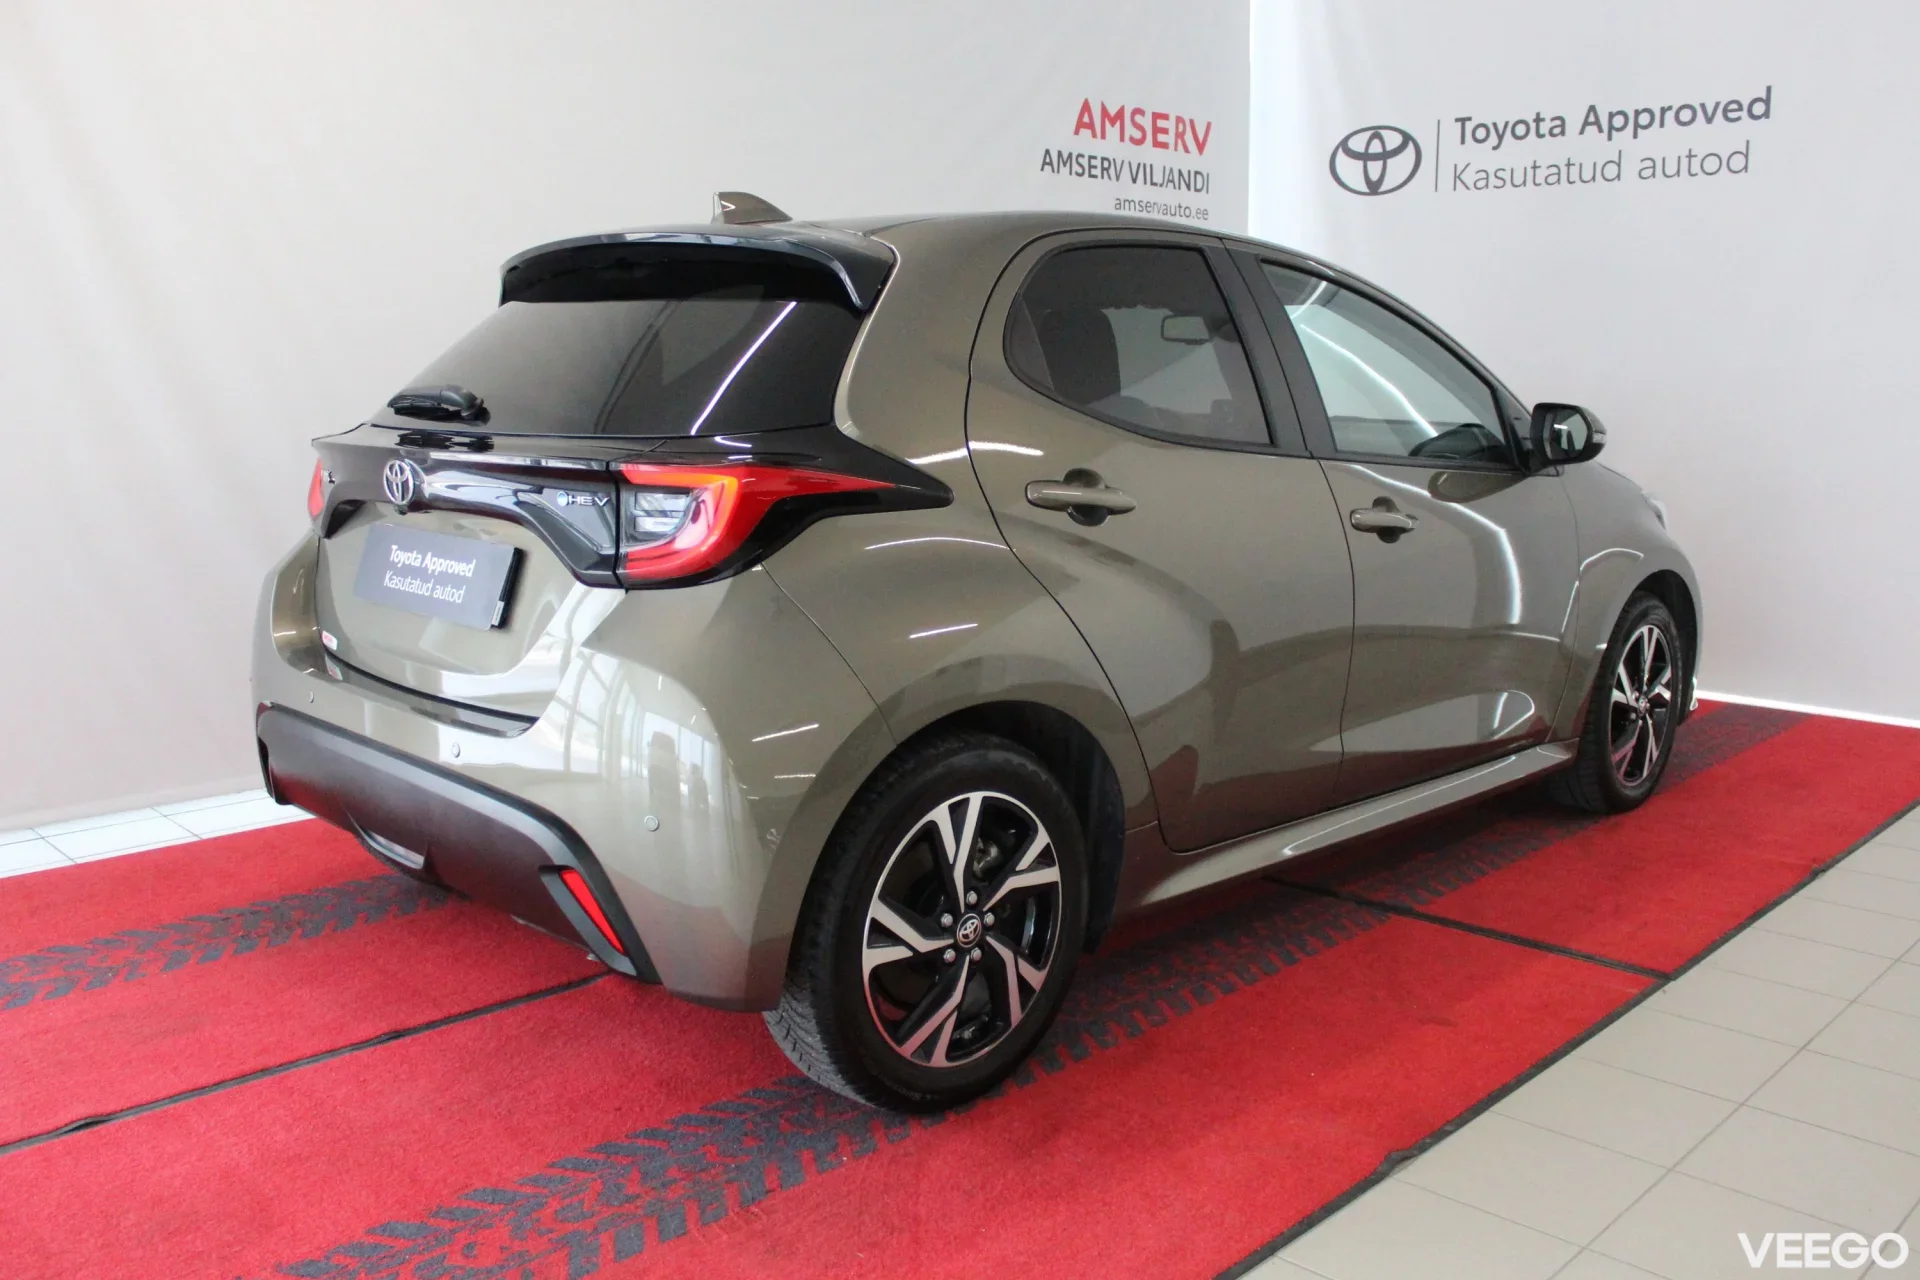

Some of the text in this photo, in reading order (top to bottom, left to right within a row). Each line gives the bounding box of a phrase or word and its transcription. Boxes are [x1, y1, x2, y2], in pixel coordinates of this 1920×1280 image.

[1073, 97, 1212, 156] AMSERV
[1454, 85, 1772, 151] Toyota Approved
[1040, 148, 1210, 194] AMSERV VILJANDI
[1452, 139, 1750, 191] Kasutatud autod
[1114, 197, 1209, 220] amservauto.ee
[568, 495, 610, 506] HEV
[390, 544, 476, 578] Toyota Approved
[383, 569, 466, 604] Kasutatud autod
